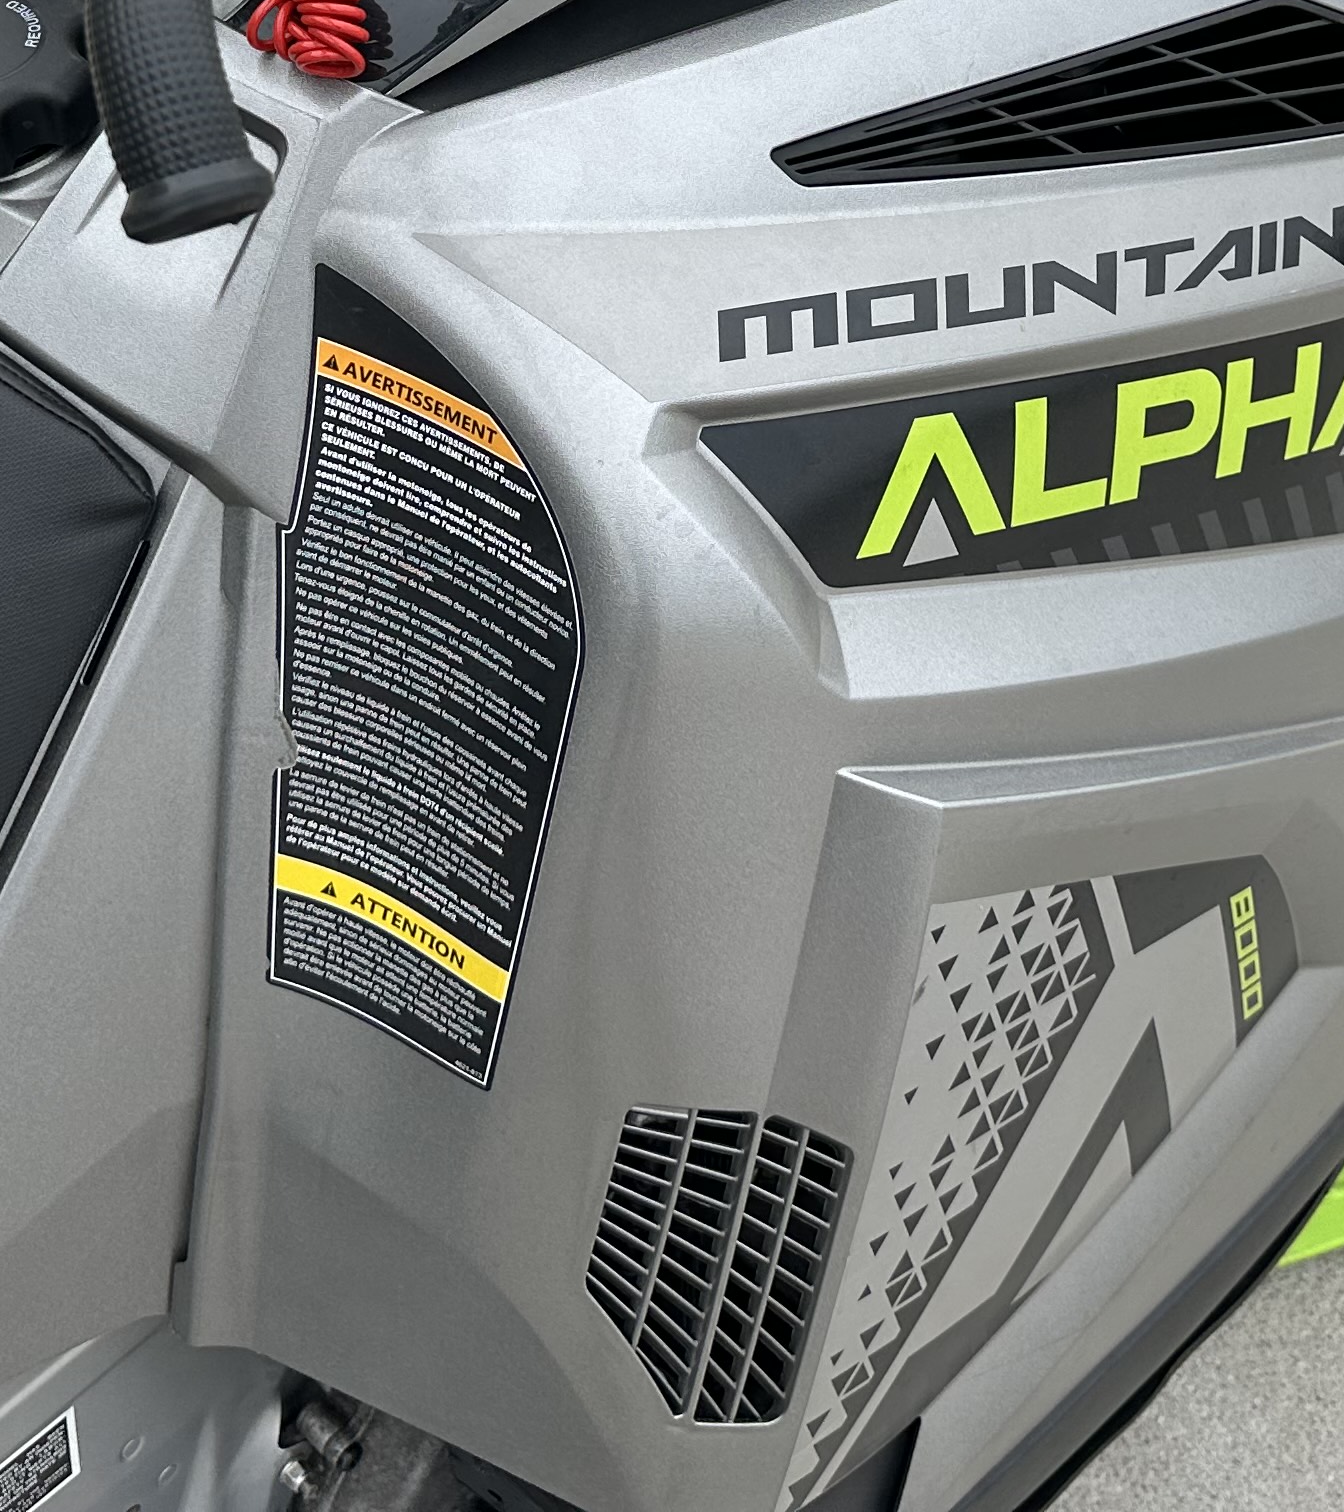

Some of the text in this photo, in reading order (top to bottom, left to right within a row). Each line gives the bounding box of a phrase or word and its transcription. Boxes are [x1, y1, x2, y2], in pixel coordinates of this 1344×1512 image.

[5, 0, 42, 48] REQUIRED
[336, 386, 361, 404] VOUS
[401, 414, 419, 428] CES
[343, 361, 498, 444] AVERTISSEMENT
[320, 446, 348, 463] Avant
[380, 443, 399, 457] EST
[429, 465, 454, 484] POUR
[424, 436, 438, 449] OU
[463, 456, 475, 469] LA
[350, 892, 465, 969] ATTENTION
[1229, 886, 1264, 1021] 8000
